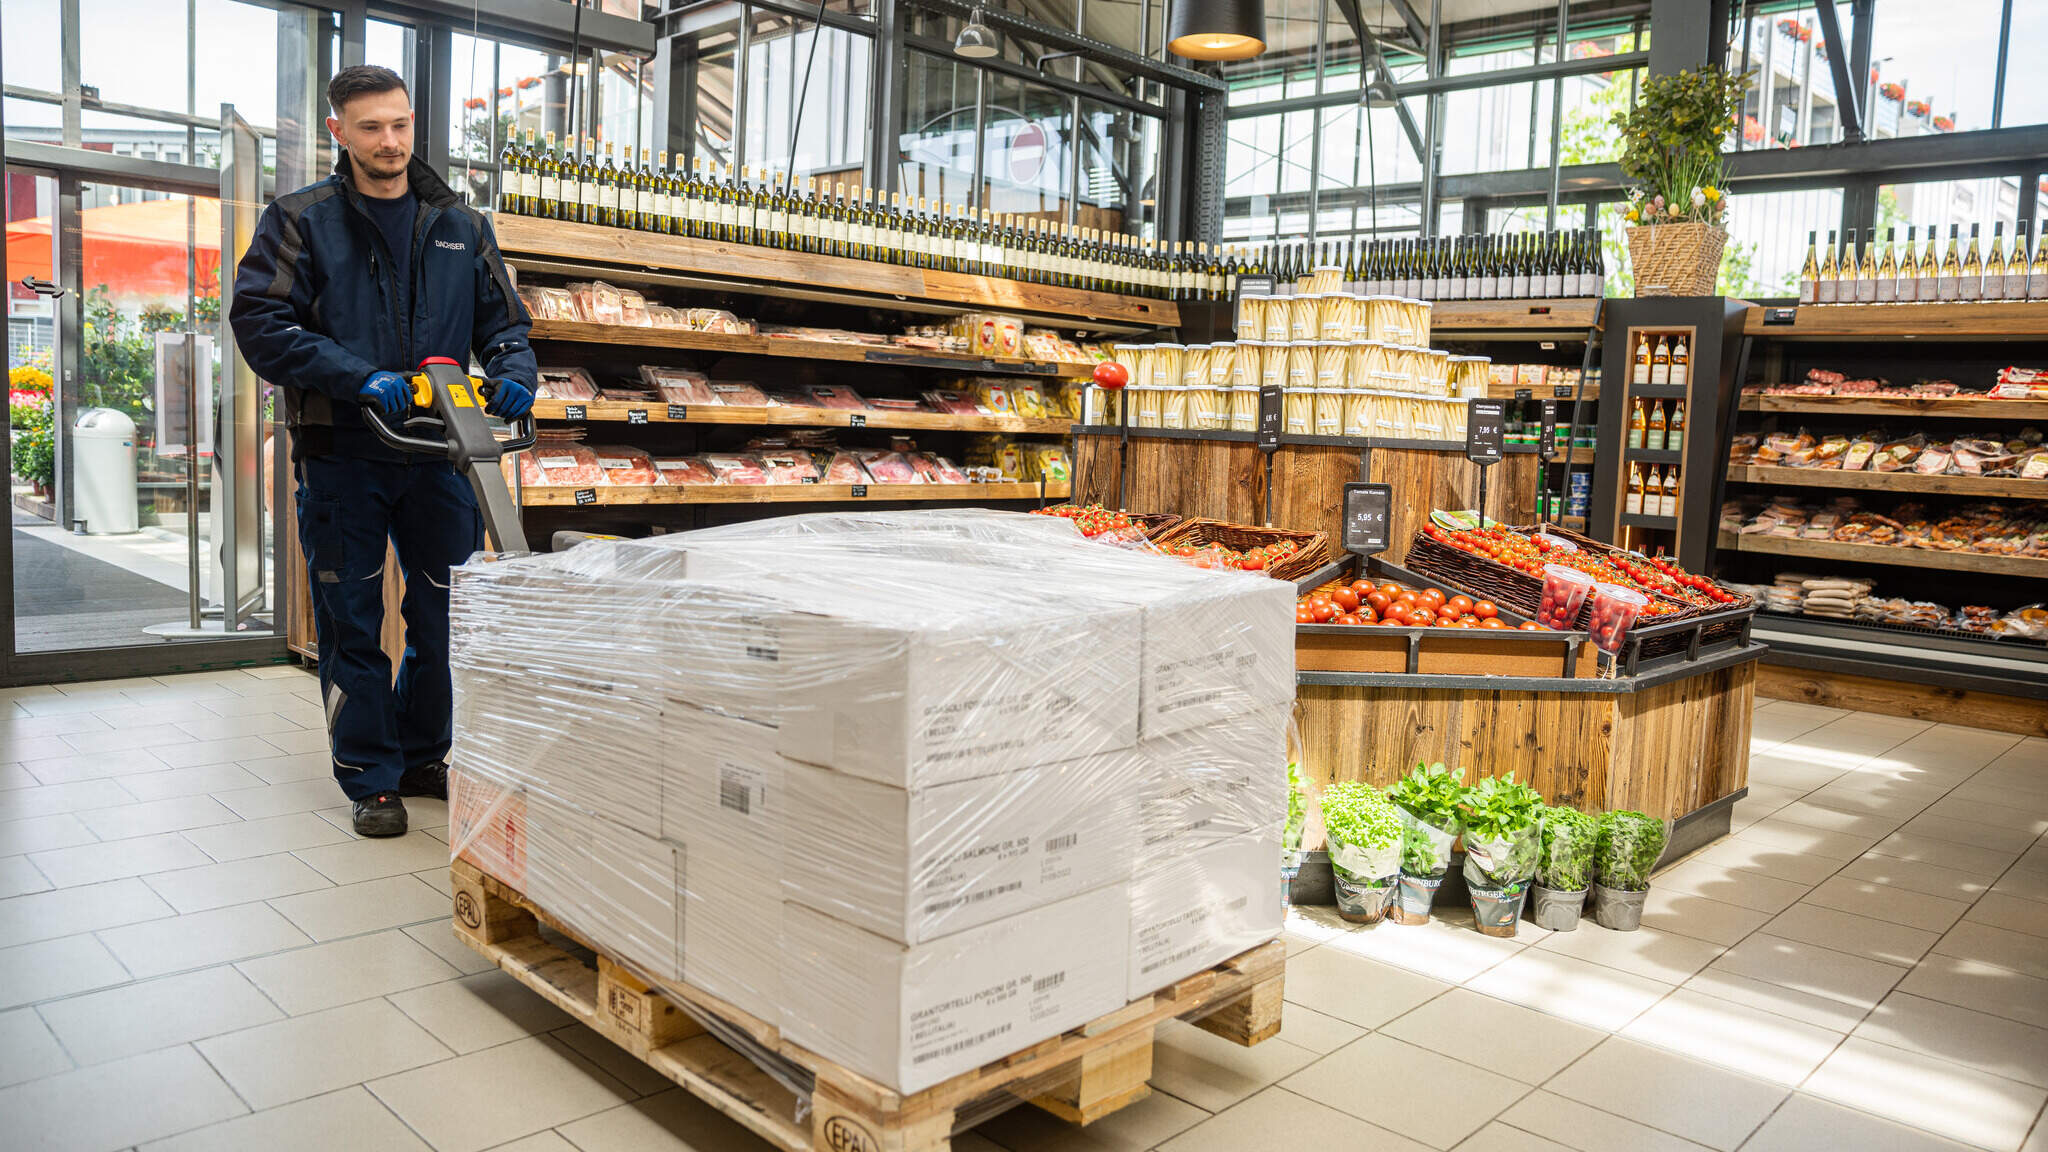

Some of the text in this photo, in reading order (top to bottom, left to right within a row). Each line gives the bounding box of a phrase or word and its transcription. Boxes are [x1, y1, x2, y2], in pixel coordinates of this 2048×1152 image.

[435, 240, 465, 250] DACHSER
[1357, 513, 1383, 522] 5,95 €
[459, 896, 477, 924] EPAL
[910, 995, 973, 1022] GRANTORTELLI
[974, 983, 1005, 1002] PORCINI
